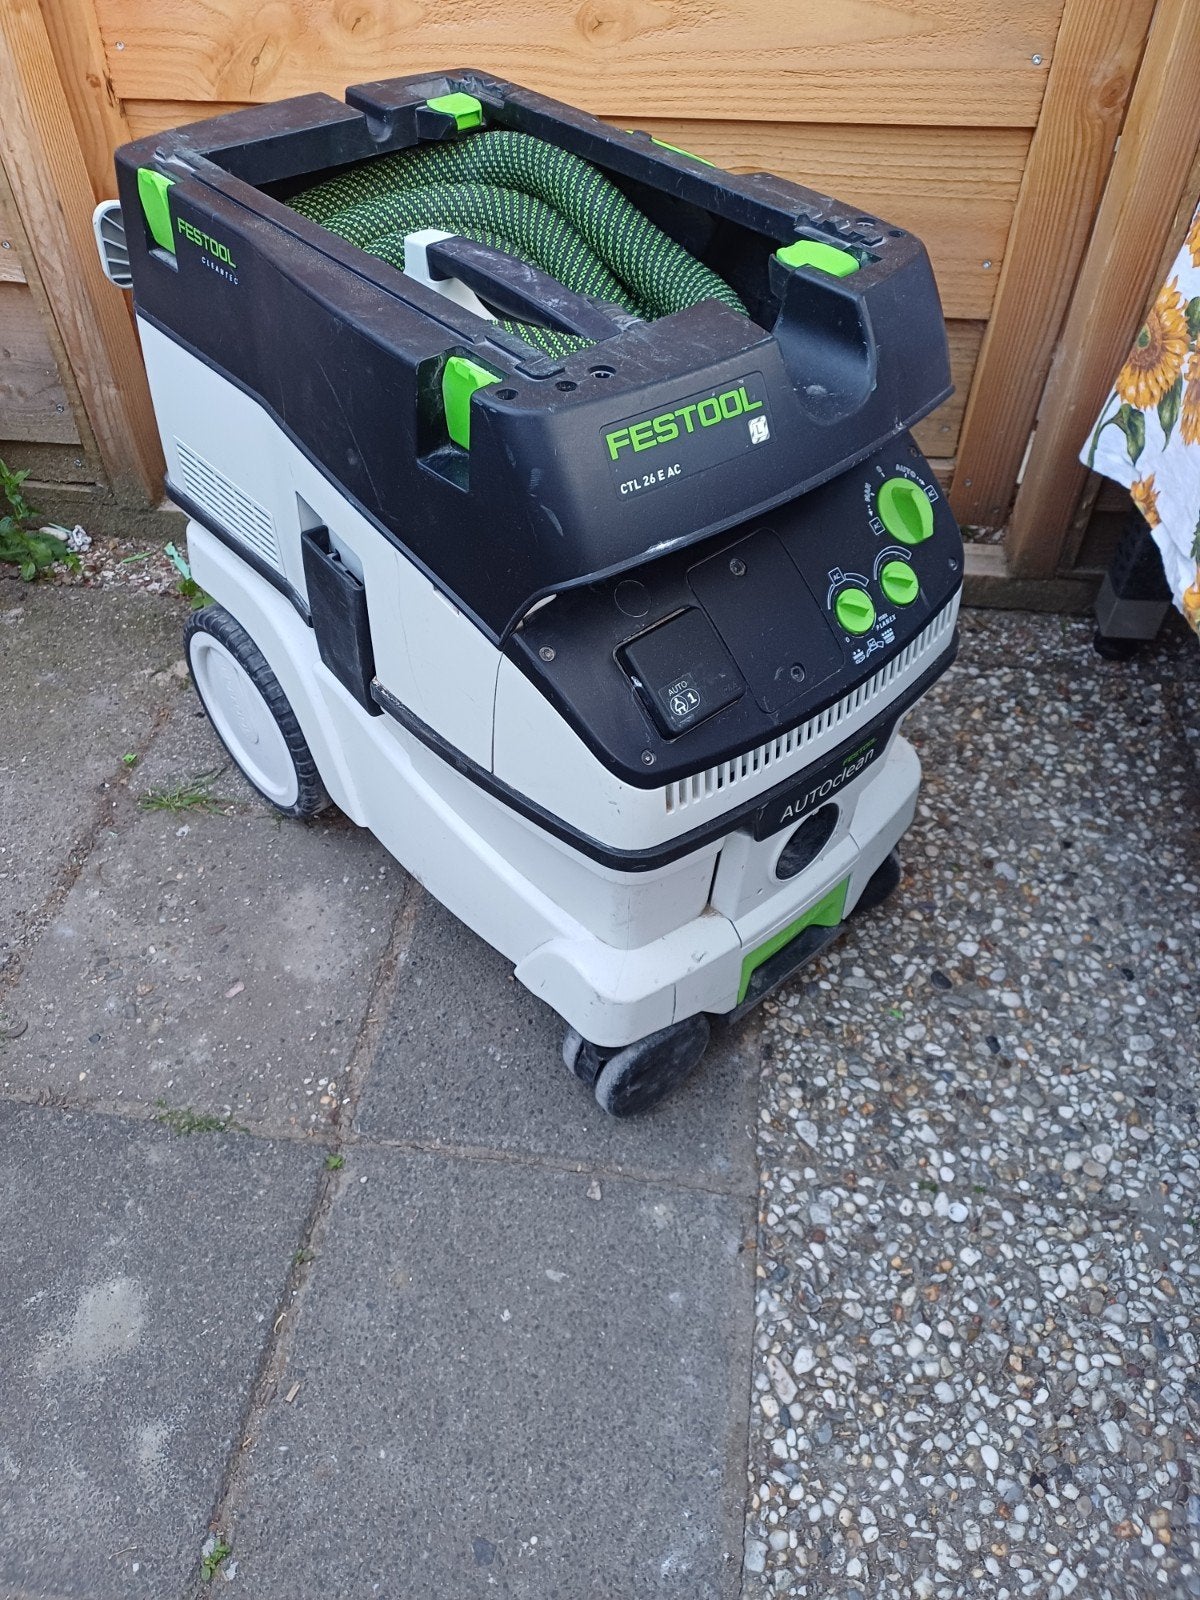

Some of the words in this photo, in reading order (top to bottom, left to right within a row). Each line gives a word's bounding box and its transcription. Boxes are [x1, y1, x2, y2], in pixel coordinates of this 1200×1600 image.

[177, 217, 237, 268] FESTOOL
[201, 256, 239, 285] CLEANTEC
[605, 386, 763, 460] FESTOOL
[620, 480, 642, 494] CTL
[643, 474, 657, 487] 26
[657, 469, 666, 482] E
[667, 463, 682, 478] AC
[895, 463, 917, 478] AUTO
[668, 680, 688, 697] AUTO
[687, 692, 698, 704] 1
[780, 748, 875, 823] AUTOclean
